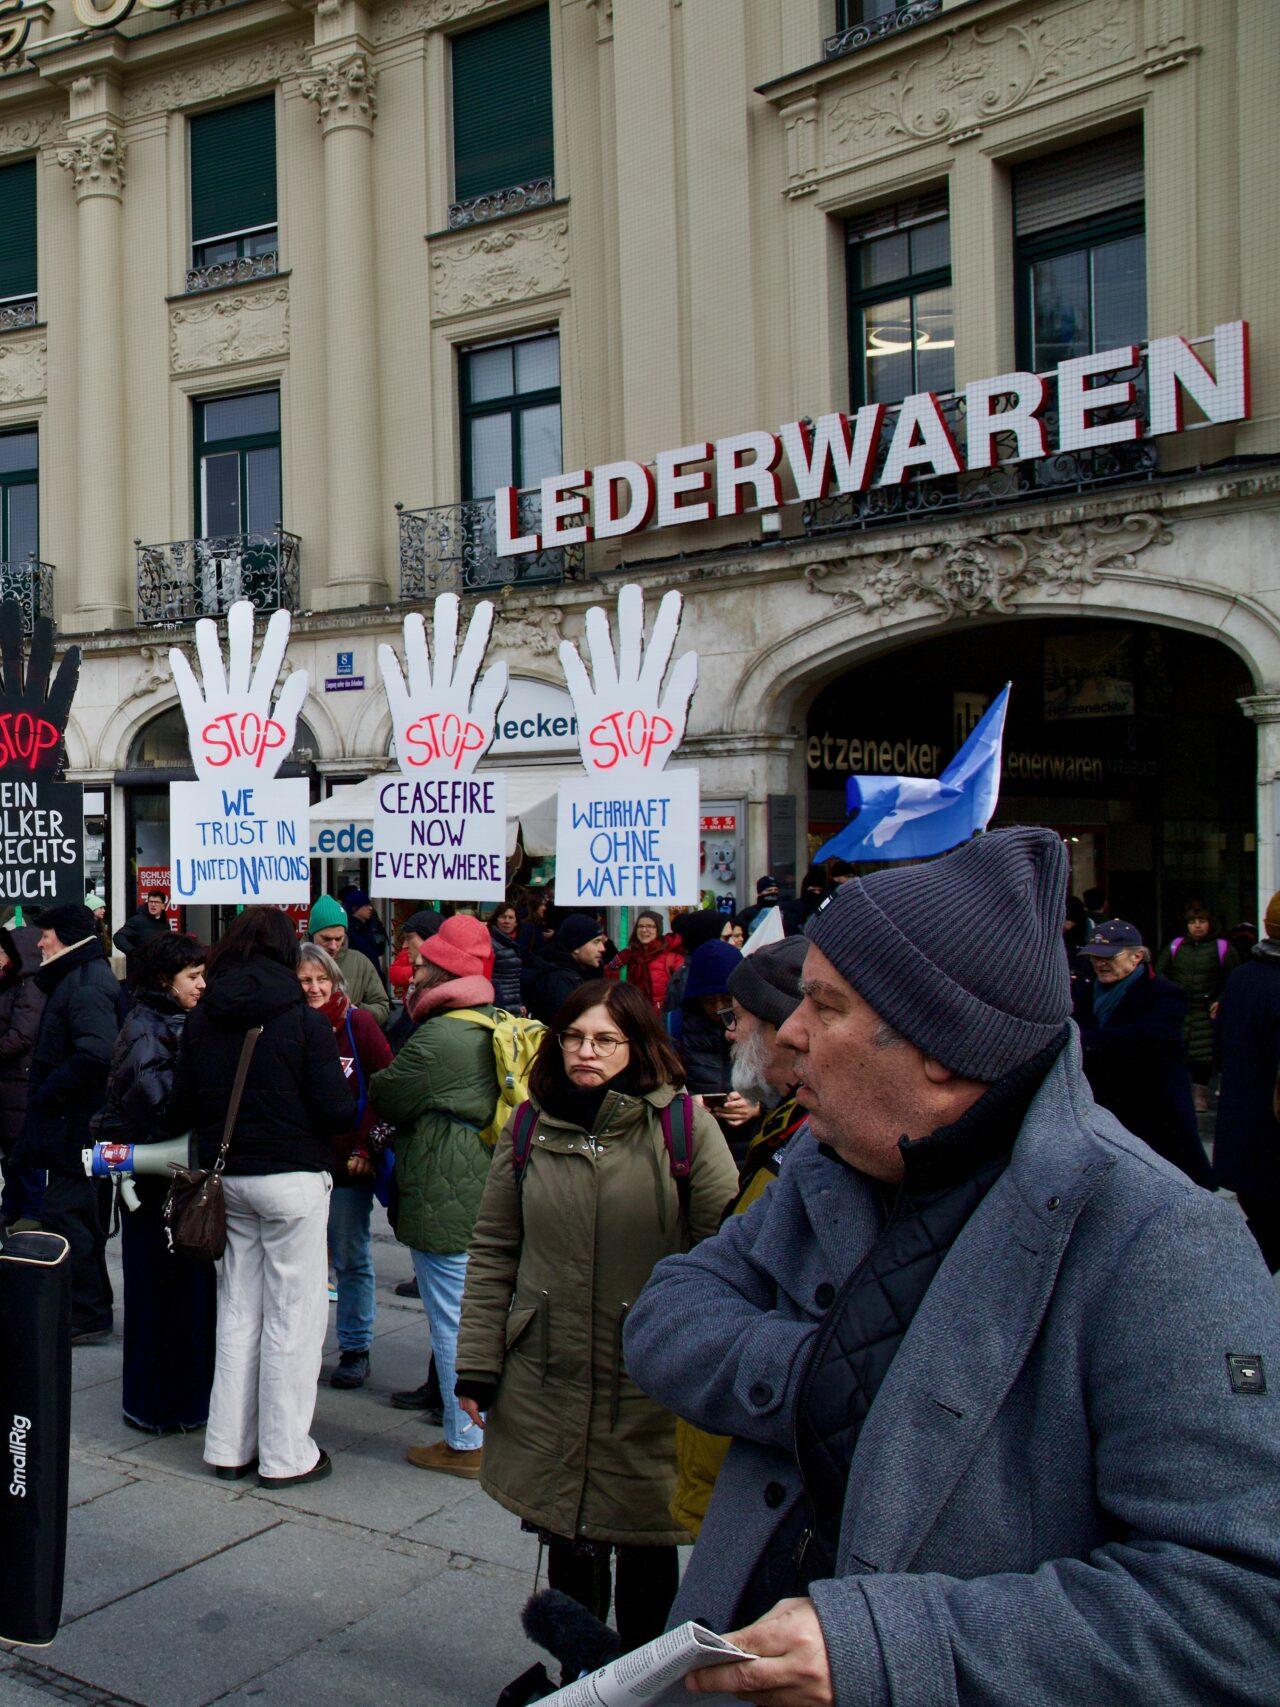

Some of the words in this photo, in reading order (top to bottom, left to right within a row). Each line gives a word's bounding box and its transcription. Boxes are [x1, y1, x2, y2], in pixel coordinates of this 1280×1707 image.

[495, 319, 1253, 557] LEDERWAREN
[202, 712, 287, 768] STOP
[406, 712, 485, 770] STOP
[495, 713, 578, 740] ecker
[589, 709, 674, 769] STOP
[806, 731, 942, 774] etzenecker
[222, 788, 255, 816] WE
[379, 781, 496, 814] CEASEFIRE
[572, 798, 671, 830] WEHRHAFT
[196, 820, 269, 847] TRUST
[277, 821, 296, 846] IN
[310, 823, 374, 854] ede
[410, 818, 466, 847] NOW
[589, 830, 660, 864] OHNE
[141, 871, 171, 879] SCHLUS
[375, 851, 502, 882] EVERYWHERE
[577, 863, 676, 898] WAFFEN
[141, 879, 171, 887] VERKAU
[8, 1413, 33, 1498] SmallRig
